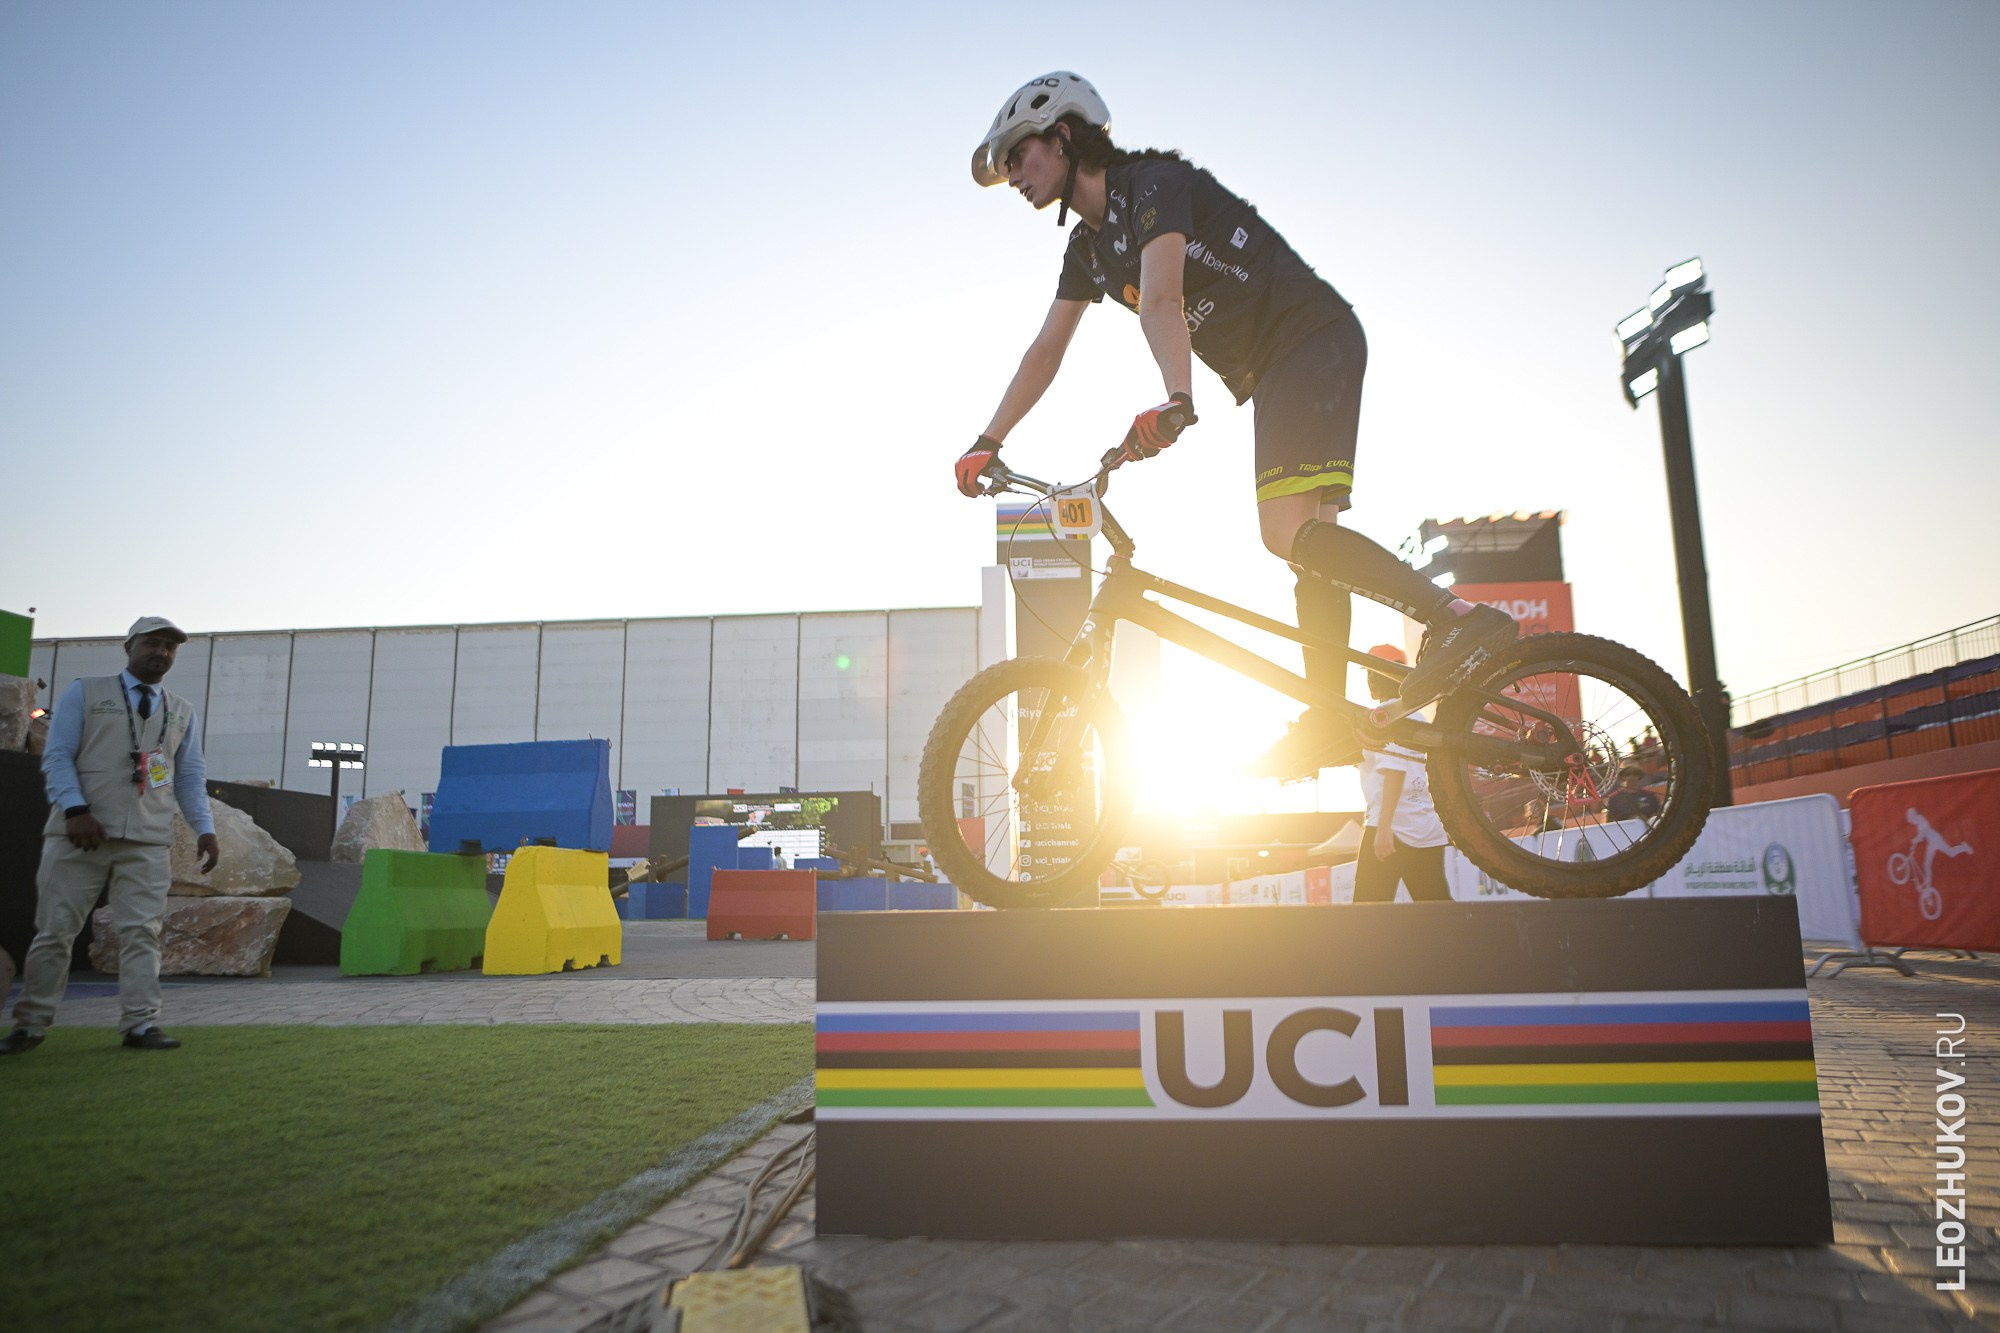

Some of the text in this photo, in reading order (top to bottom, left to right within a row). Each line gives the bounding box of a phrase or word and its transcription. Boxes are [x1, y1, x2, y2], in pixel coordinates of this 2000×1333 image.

[1062, 502, 1086, 524] 401
[1012, 559, 1031, 567] UCI
[1153, 1006, 1410, 1109] UCI
